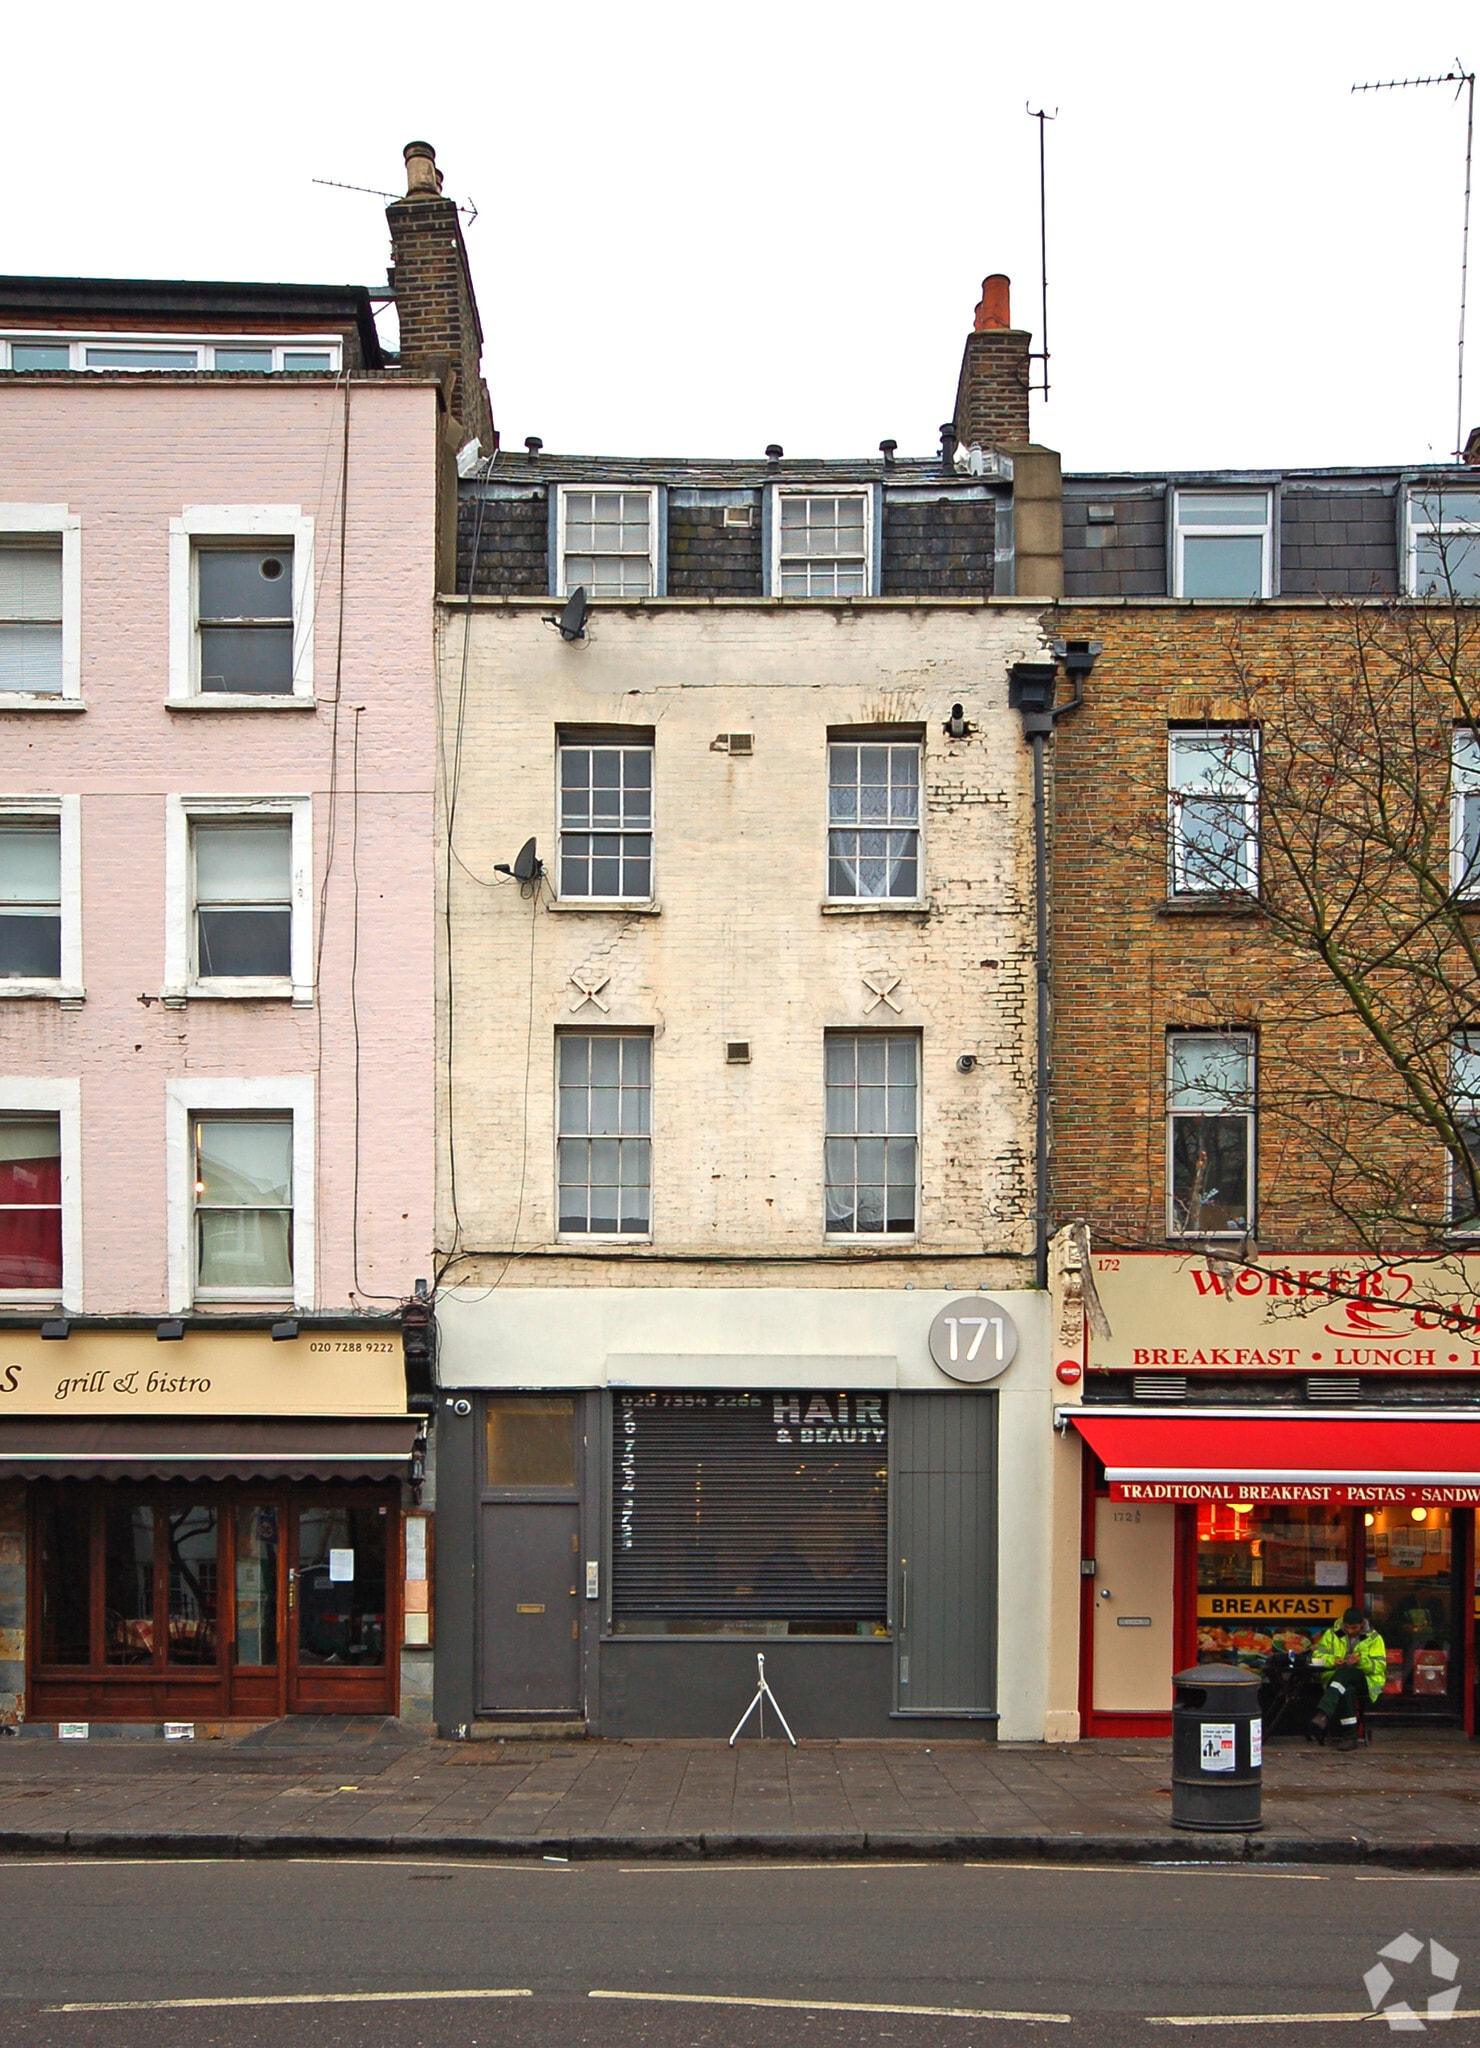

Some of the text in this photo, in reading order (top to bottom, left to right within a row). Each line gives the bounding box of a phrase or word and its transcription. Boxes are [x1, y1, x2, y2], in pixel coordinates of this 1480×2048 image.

[1097, 1259, 1120, 1271] 172
[944, 1317, 1004, 1361] 171
[310, 1342, 393, 1353] 020 7288 9222
[1133, 1349, 1436, 1366] BREAKFAST LUNCH
[54, 1371, 212, 1399] grill & bistro
[621, 1394, 657, 1407] 020
[776, 1428, 886, 1443] & BEAUTY
[1121, 1484, 1234, 1499] TRADITIONAL
[1238, 1486, 1332, 1501] BREAKFAST
[1347, 1487, 1406, 1501] PASTAS
[1114, 1512, 1132, 1521] 172
[1211, 1598, 1334, 1614] BREAKFAST
